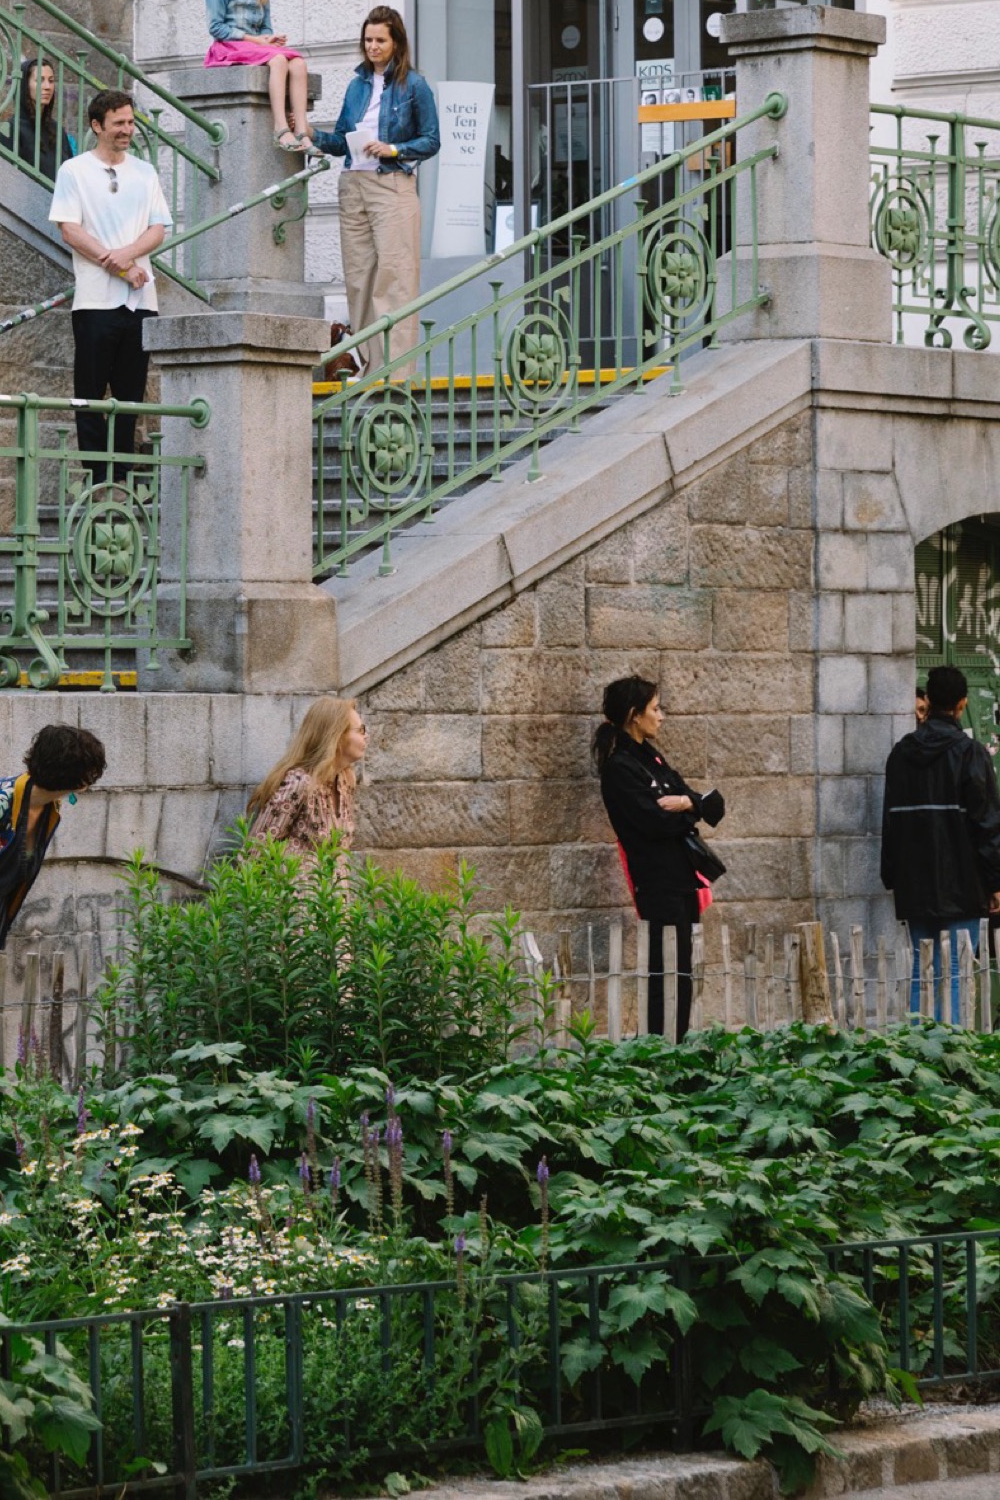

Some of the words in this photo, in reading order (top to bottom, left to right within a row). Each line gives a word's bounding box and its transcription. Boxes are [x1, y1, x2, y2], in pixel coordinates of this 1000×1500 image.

[446, 103, 477, 113] strei
[455, 115, 477, 127] fen
[453, 129, 476, 140] wei
[460, 145, 476, 154] se
